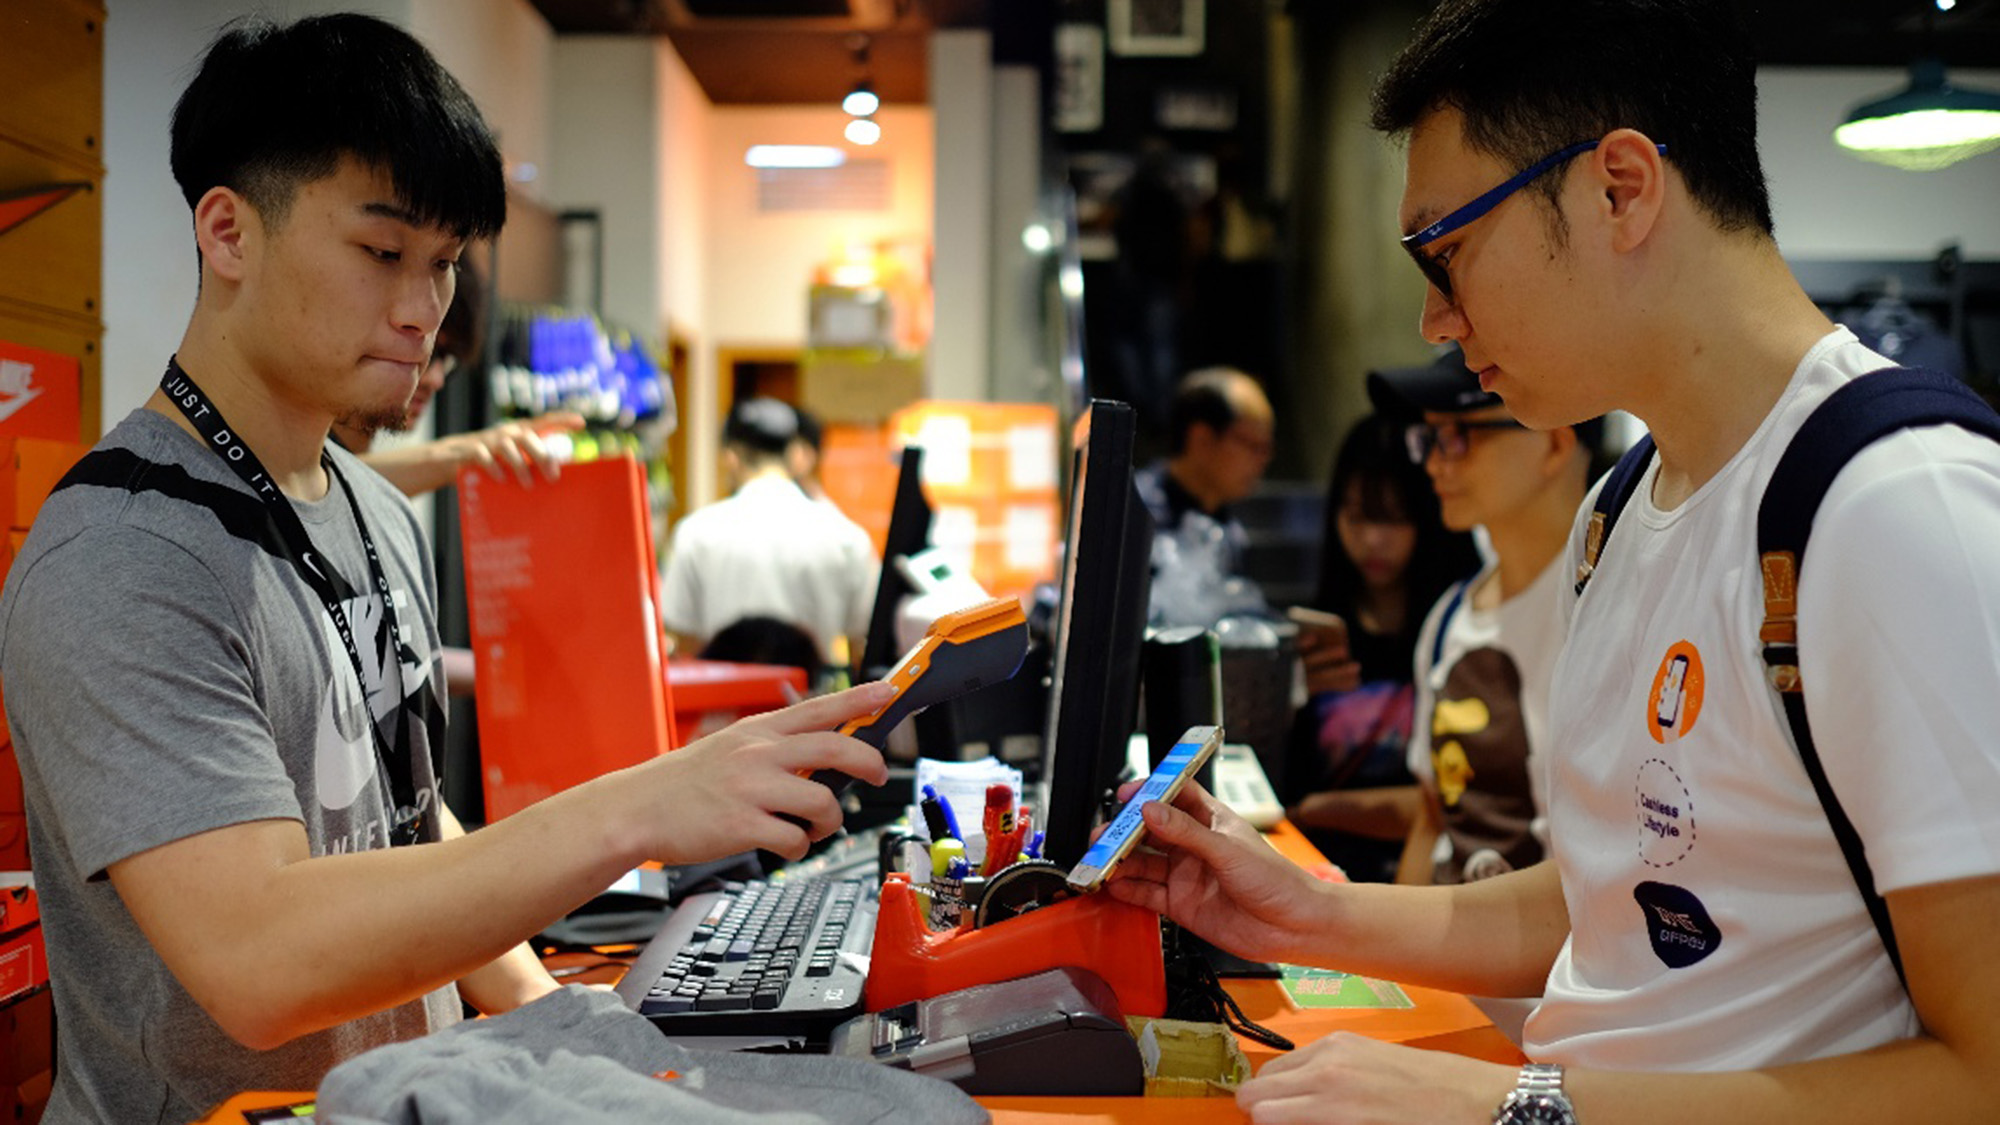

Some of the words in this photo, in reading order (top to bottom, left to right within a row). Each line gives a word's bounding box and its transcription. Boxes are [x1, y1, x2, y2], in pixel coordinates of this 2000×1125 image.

[166, 377, 210, 418] JUST
[213, 430, 245, 461] DO
[328, 601, 356, 655] JUST
[1640, 793, 1679, 819] Cashless
